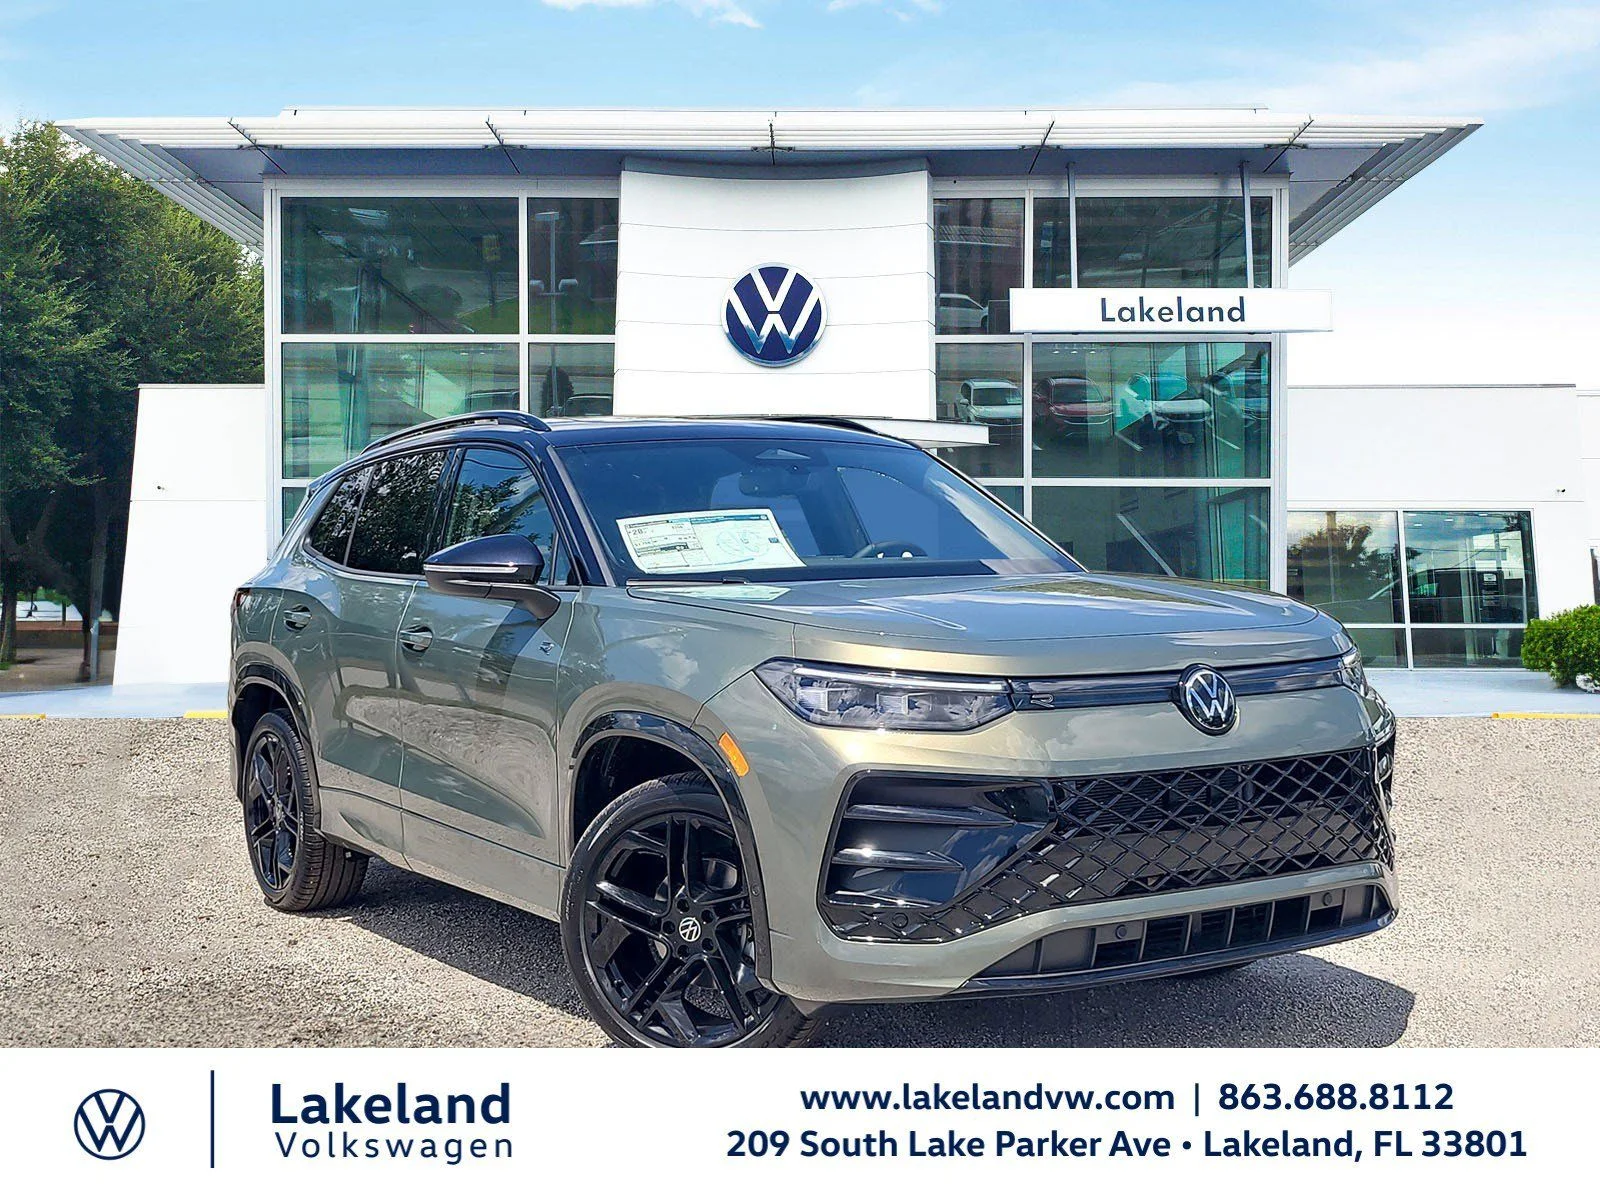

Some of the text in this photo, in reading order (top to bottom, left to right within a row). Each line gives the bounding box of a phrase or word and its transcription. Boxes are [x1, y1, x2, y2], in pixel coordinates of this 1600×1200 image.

[722, 262, 828, 368] VW
[1101, 296, 1246, 322] Lakeland
[1186, 667, 1236, 731] VW
